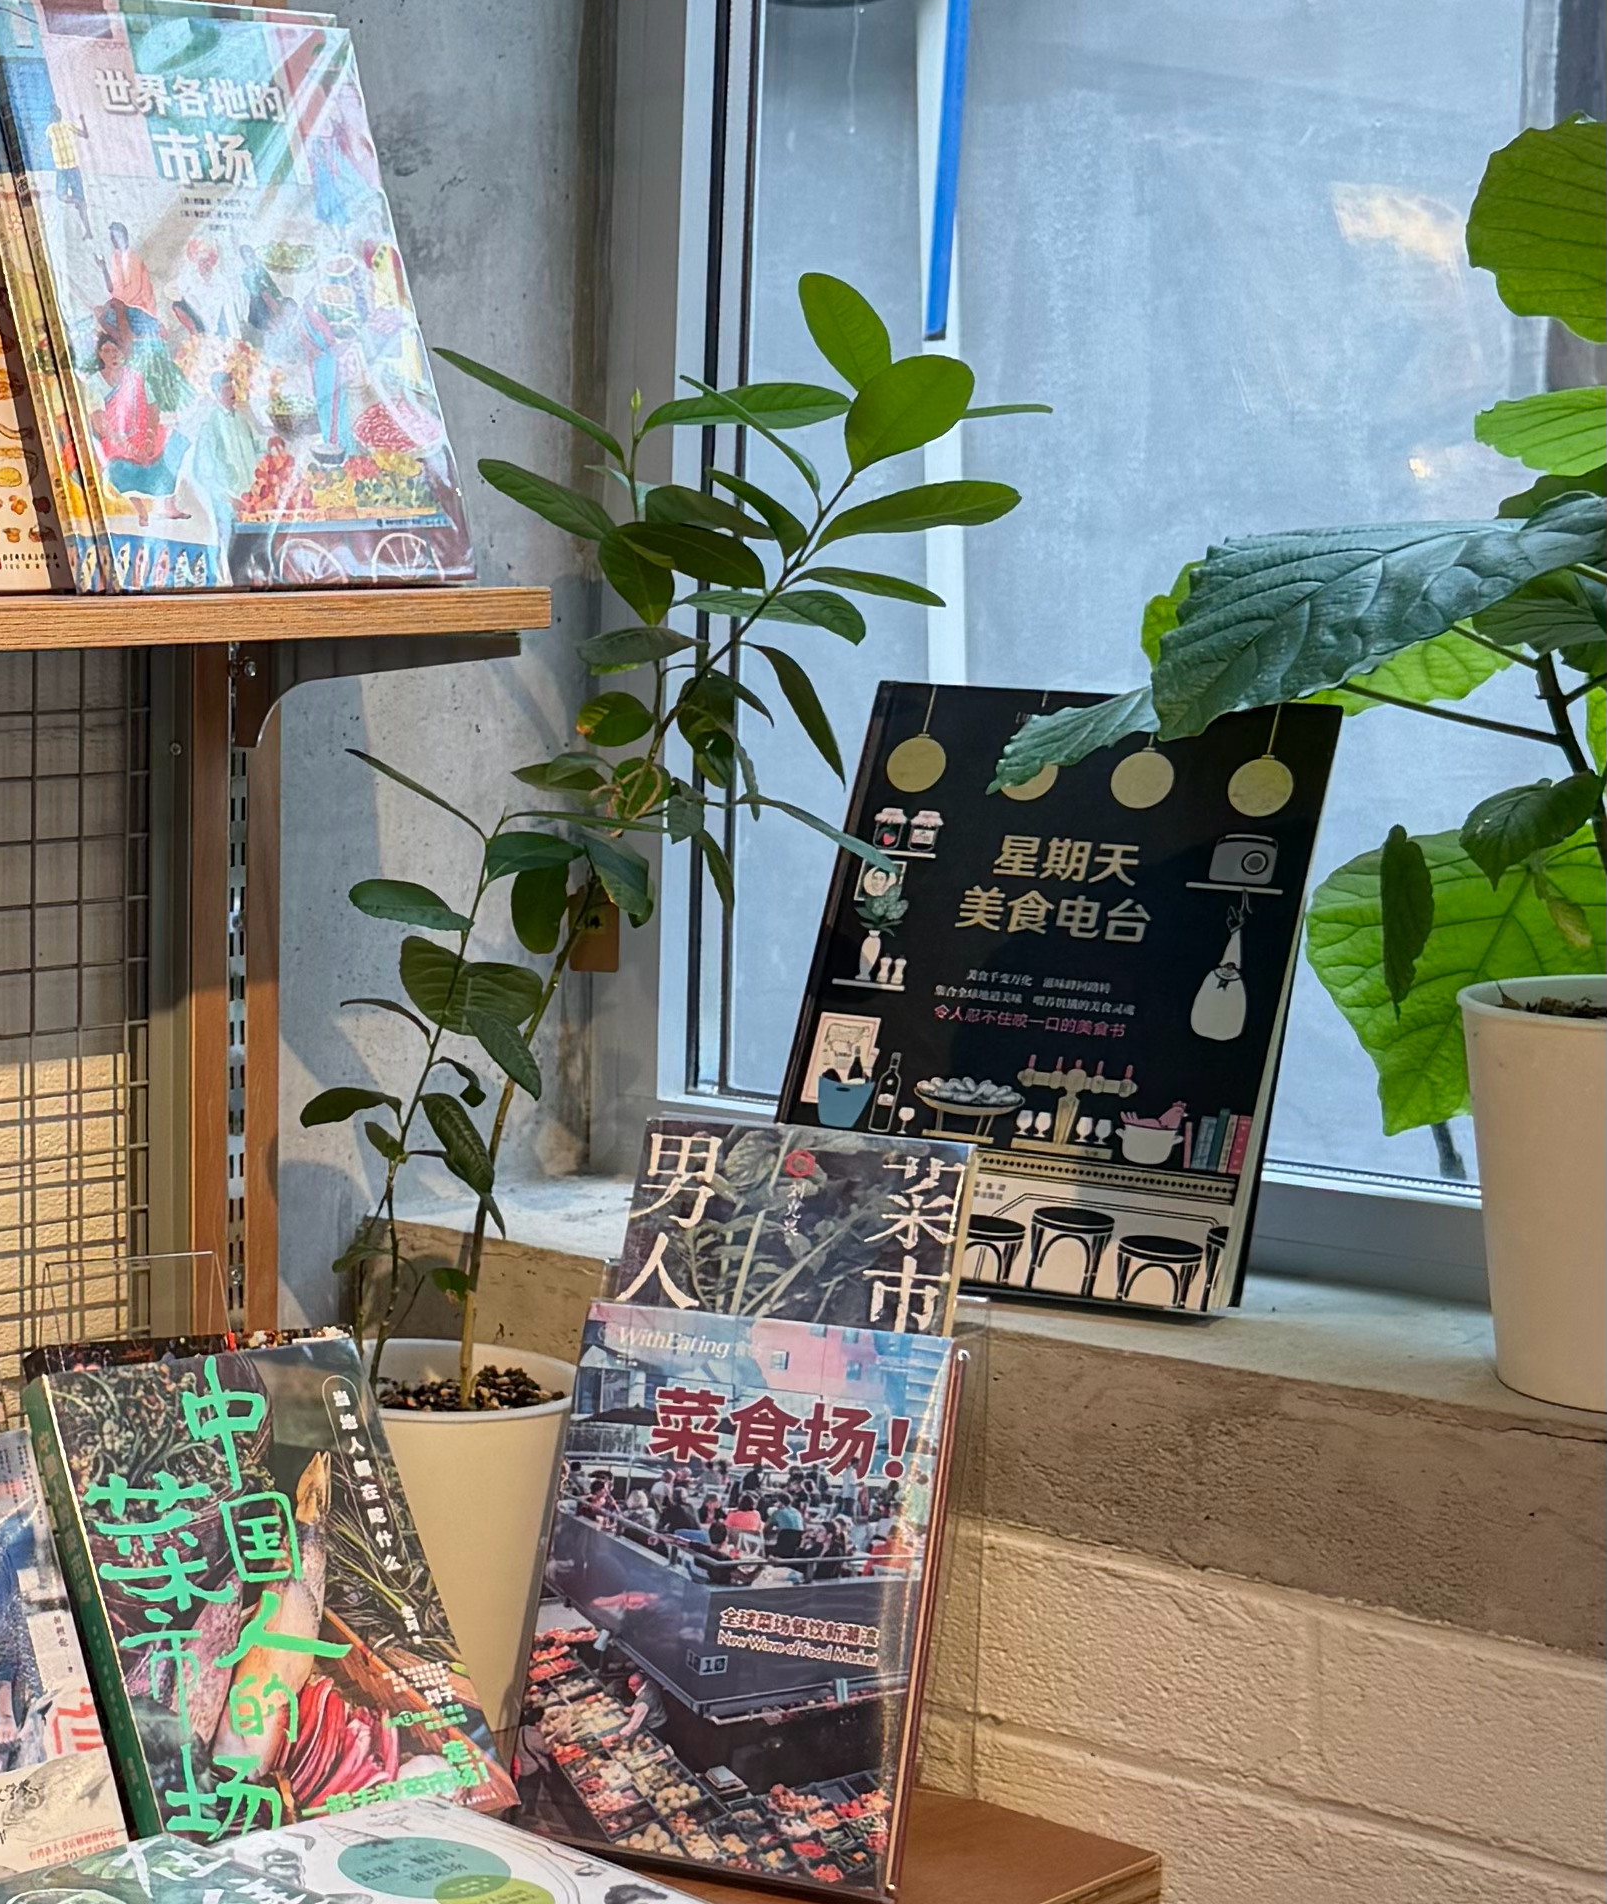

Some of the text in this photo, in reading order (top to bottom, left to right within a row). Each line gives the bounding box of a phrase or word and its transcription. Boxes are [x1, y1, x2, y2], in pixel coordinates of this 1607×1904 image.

[94, 67, 286, 125] 世界各地的
[151, 129, 258, 190] 市场
[992, 833, 1142, 887] 星期天
[954, 883, 1152, 944] 美食电台
[933, 1003, 1127, 1039] 令人忍不住咬一口的美食书
[618, 1325, 731, 1359] WithEating
[180, 1354, 354, 1745] 中国人的
[717, 1629, 747, 1648] New
[747, 1634, 785, 1655] Wave
[833, 1647, 880, 1667] Market
[719, 1606, 880, 1648] 全球菜场餐饮新潮流
[82, 1471, 282, 1844] 菜市场
